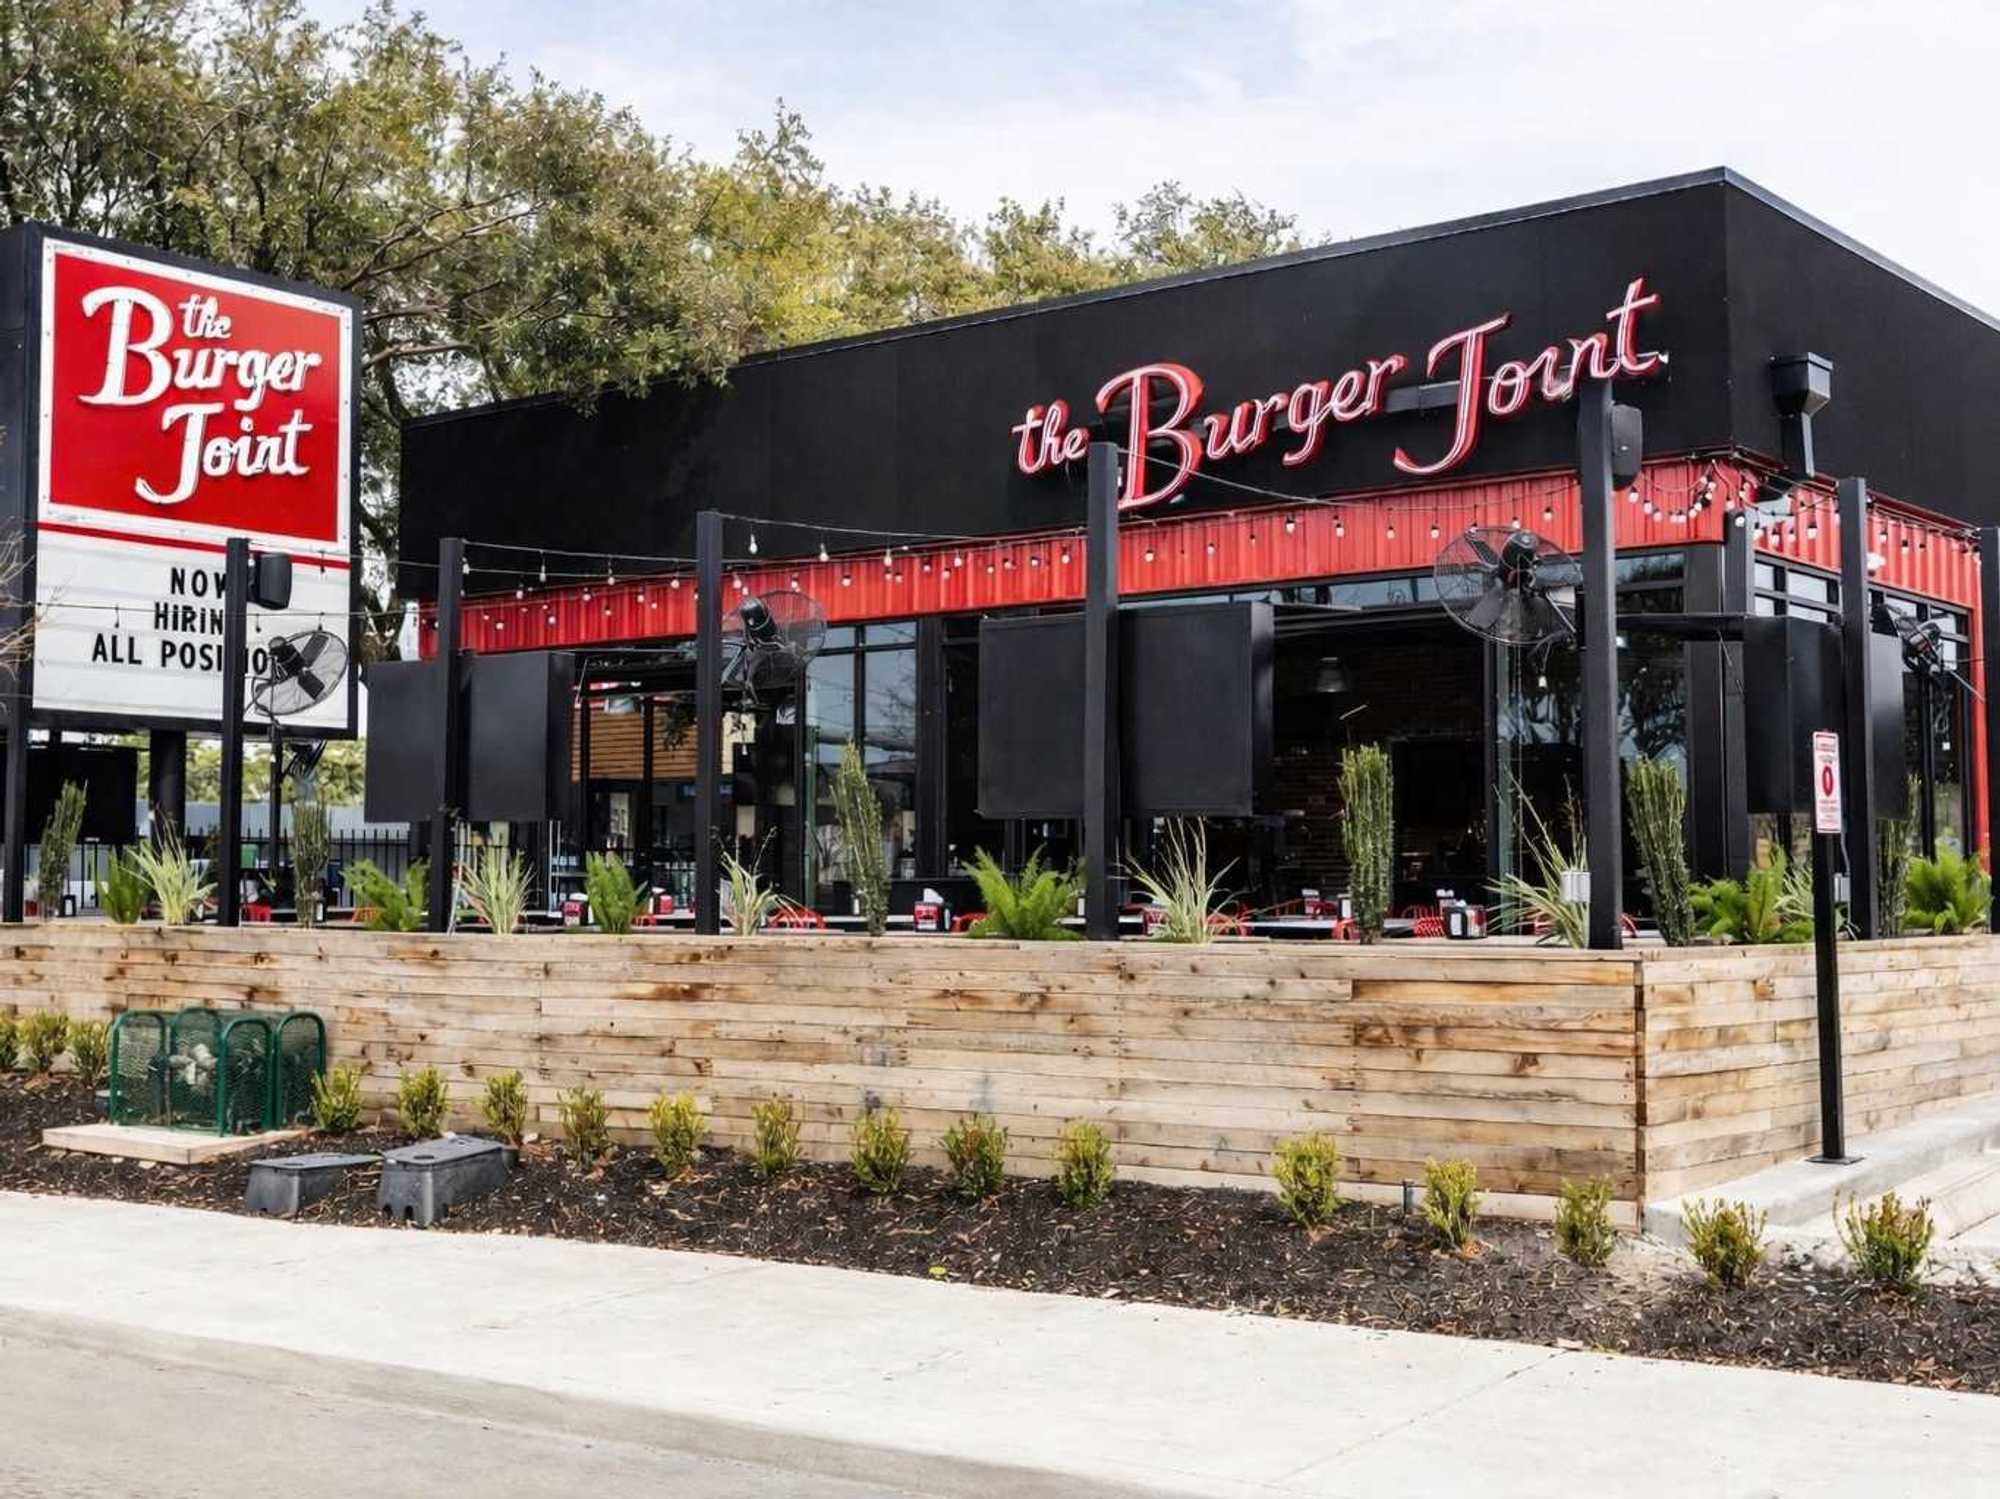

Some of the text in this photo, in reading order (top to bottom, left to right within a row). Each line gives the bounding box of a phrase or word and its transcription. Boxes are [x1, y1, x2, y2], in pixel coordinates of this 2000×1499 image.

[77, 285, 323, 412] Burger
[178, 293, 232, 339] the
[1012, 277, 1662, 510] the Burger Joint
[134, 402, 314, 505] Joint
[91, 632, 268, 676] ALL POSIIO
[154, 601, 224, 636] HIRIN
